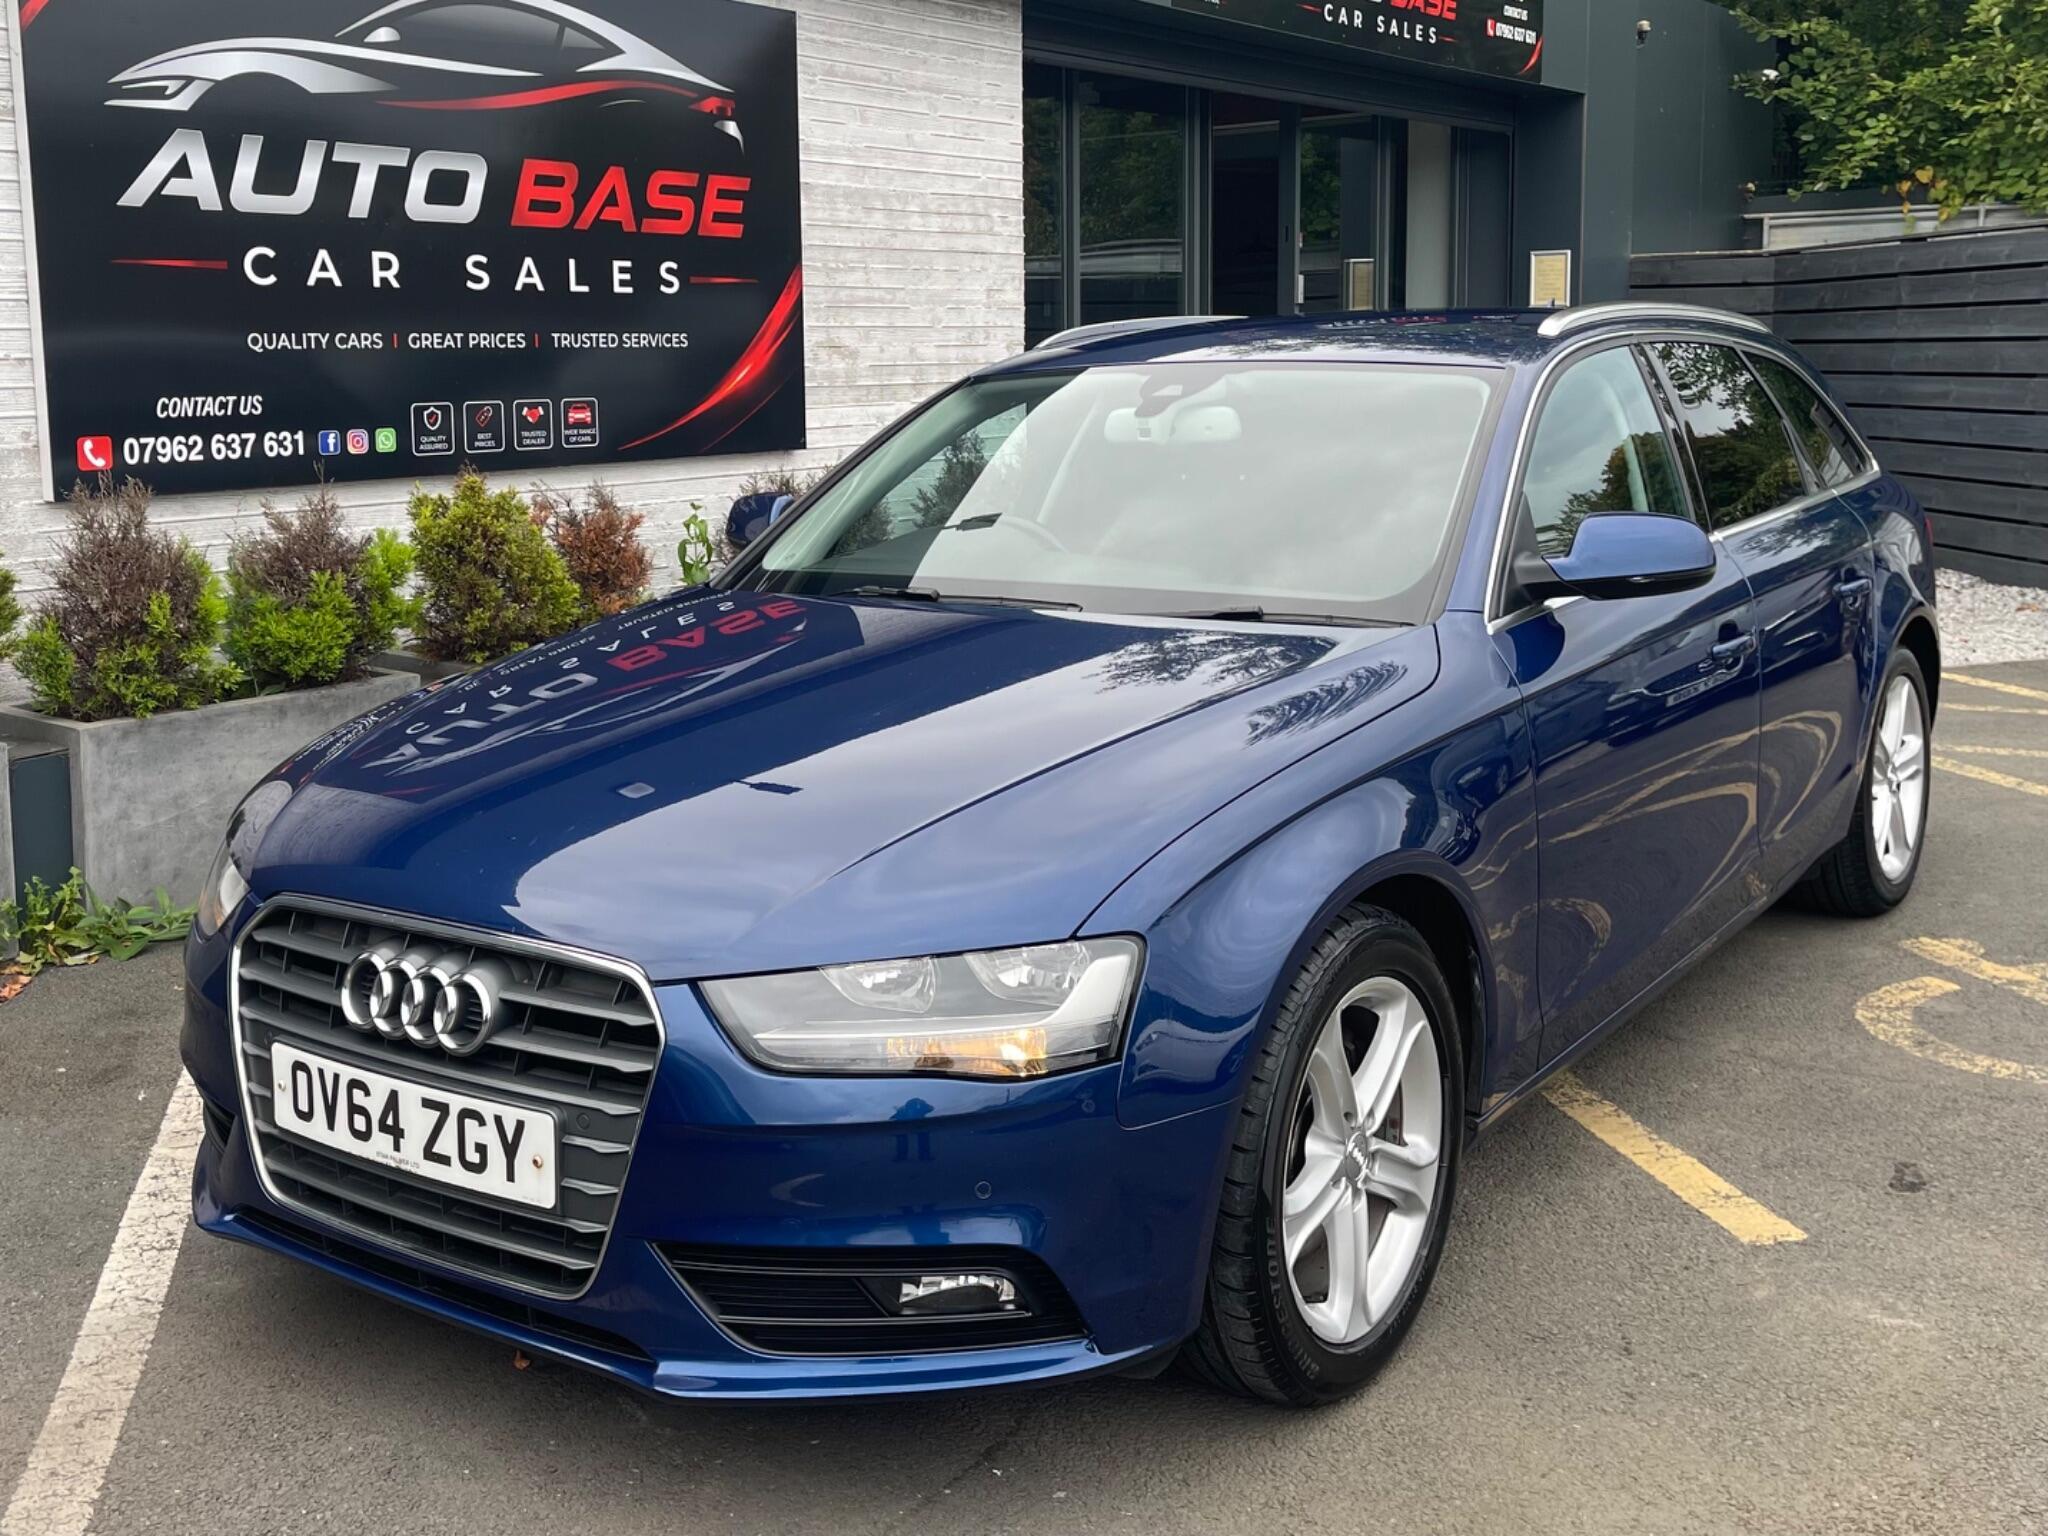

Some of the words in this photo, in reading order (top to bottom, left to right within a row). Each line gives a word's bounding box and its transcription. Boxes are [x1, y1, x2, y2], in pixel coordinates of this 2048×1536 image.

[1323, 4, 1363, 29] CAR
[1376, 15, 1437, 44] SALES
[116, 127, 489, 224] AUTO
[510, 158, 751, 239] BASE
[242, 246, 400, 287] CAR
[464, 253, 681, 295] SALES
[246, 332, 330, 352] QUALITY
[334, 332, 384, 349] CARS
[407, 332, 463, 349] GREAT
[468, 332, 526, 349] PRICES
[551, 332, 619, 348] TRUSTED
[622, 332, 689, 348] SERVICES
[156, 395, 236, 419] CONTACT
[240, 394, 263, 416] US
[122, 434, 205, 467] 07962
[210, 432, 257, 461] 637
[262, 429, 305, 457] 631
[290, 1059, 406, 1153] OV64
[420, 1096, 526, 1184] ZGY
